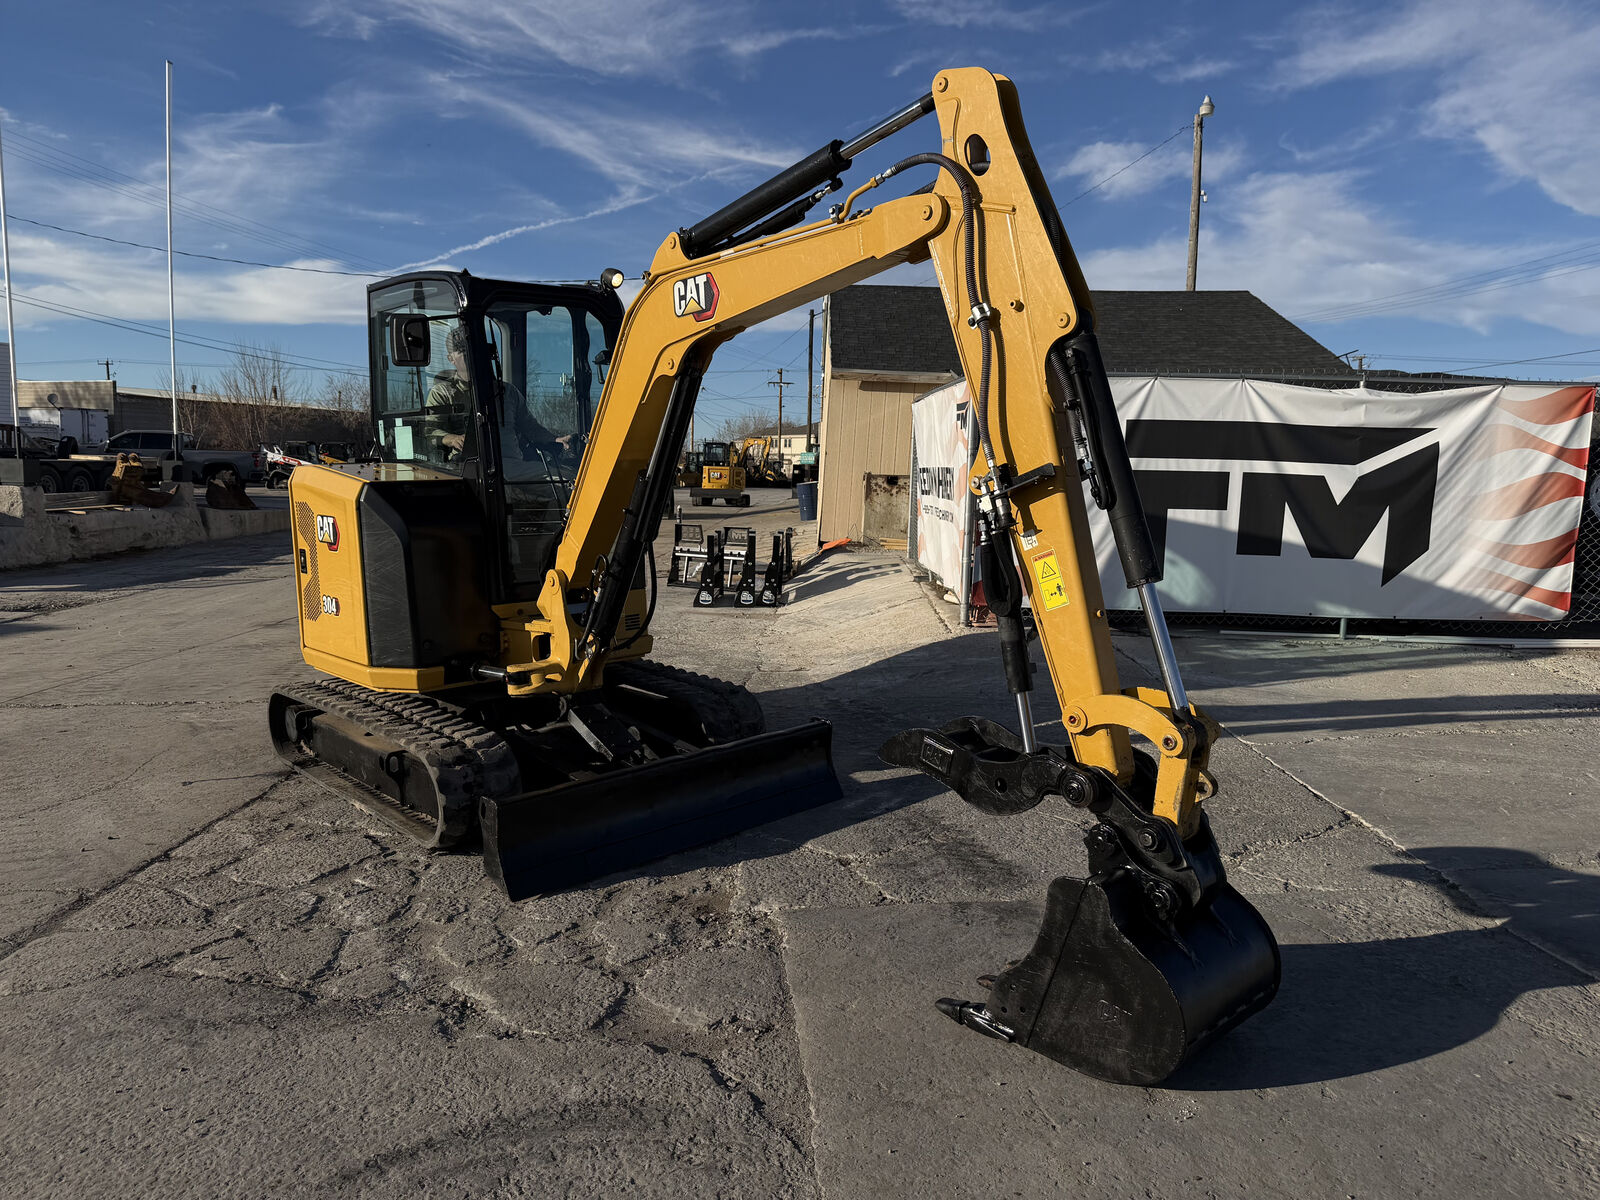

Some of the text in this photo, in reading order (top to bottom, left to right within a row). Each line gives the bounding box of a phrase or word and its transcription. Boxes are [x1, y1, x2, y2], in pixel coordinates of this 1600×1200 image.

[674, 273, 707, 316] CAT
[317, 515, 334, 543] CAT
[322, 595, 336, 614] 304
